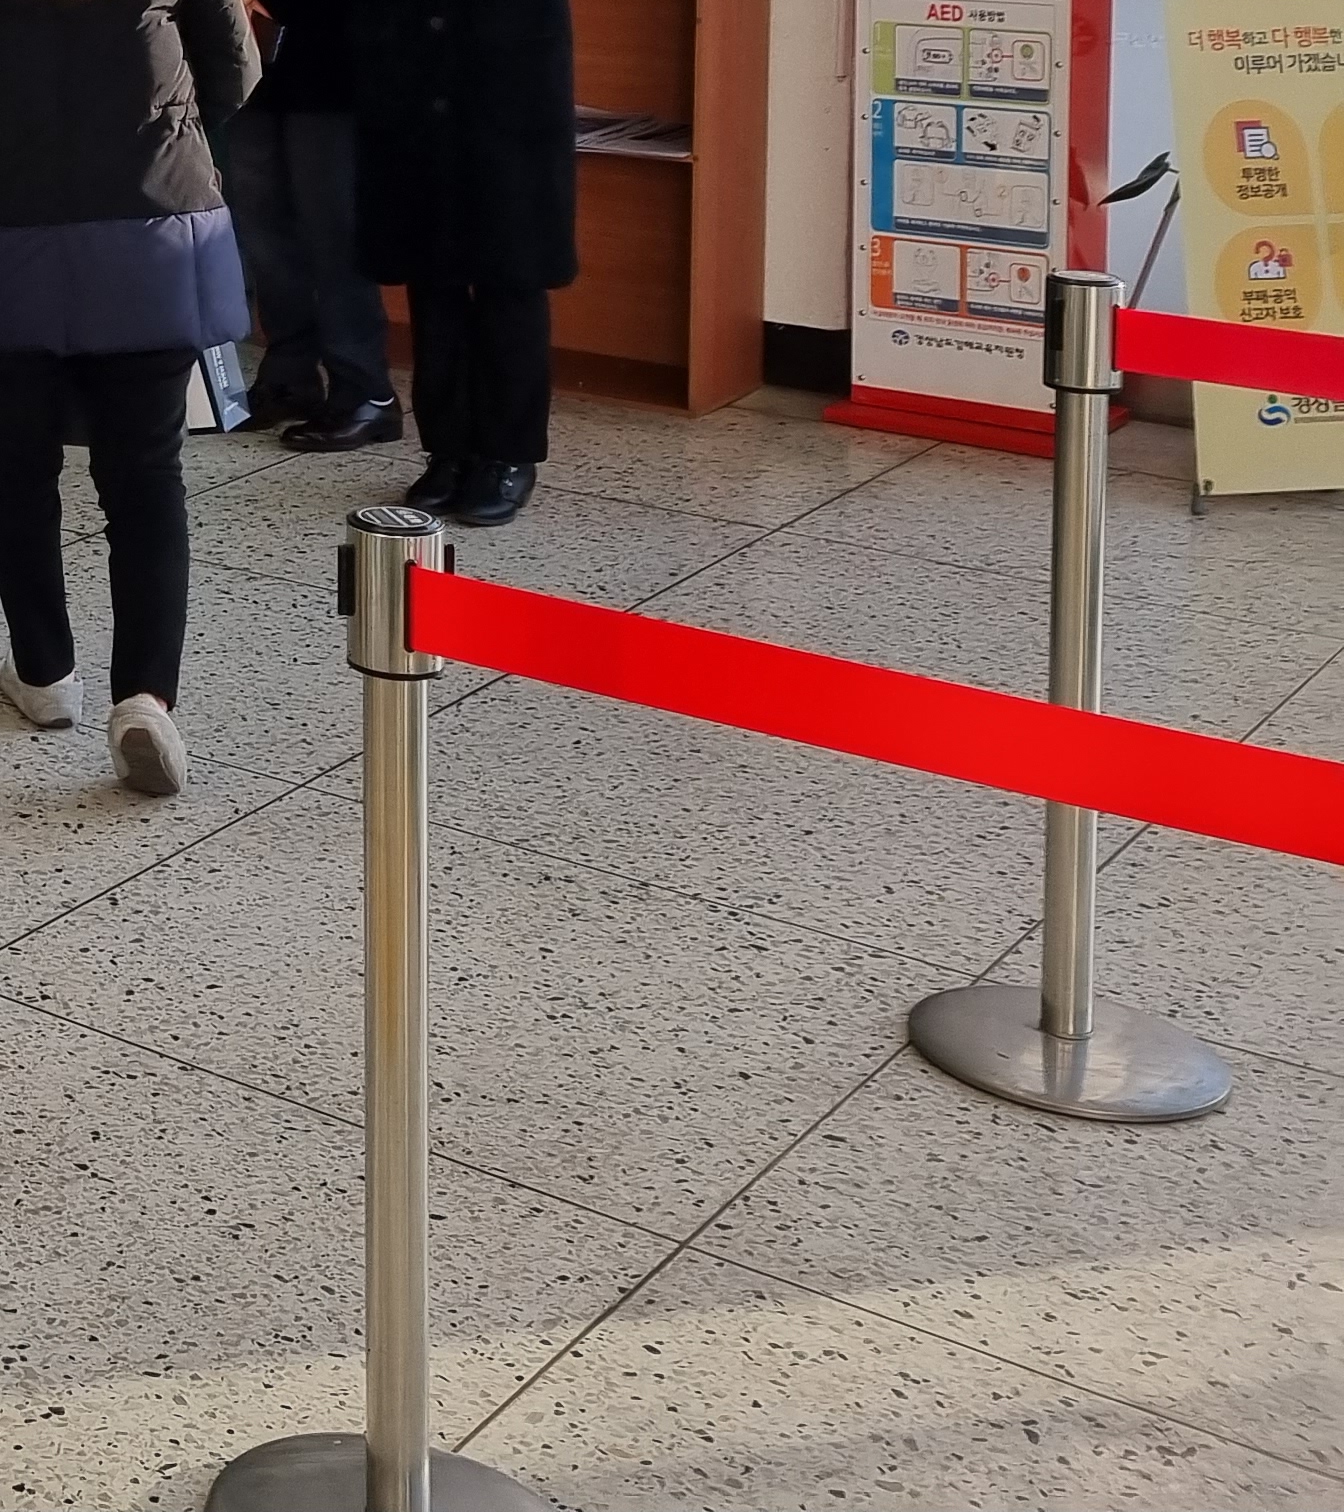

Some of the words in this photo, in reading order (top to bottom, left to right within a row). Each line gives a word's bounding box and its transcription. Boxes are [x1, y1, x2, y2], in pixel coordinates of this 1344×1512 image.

[926, 3, 964, 22] AED
[1188, 29, 1204, 51] 더
[1207, 28, 1269, 51] 행복하고
[1272, 27, 1289, 49] 다
[1234, 54, 1283, 75] 이루어
[1241, 167, 1280, 182] 투명한
[1236, 183, 1288, 200] 정보공개
[1240, 306, 1277, 323] 신고자
[1279, 305, 1305, 320] 보호
